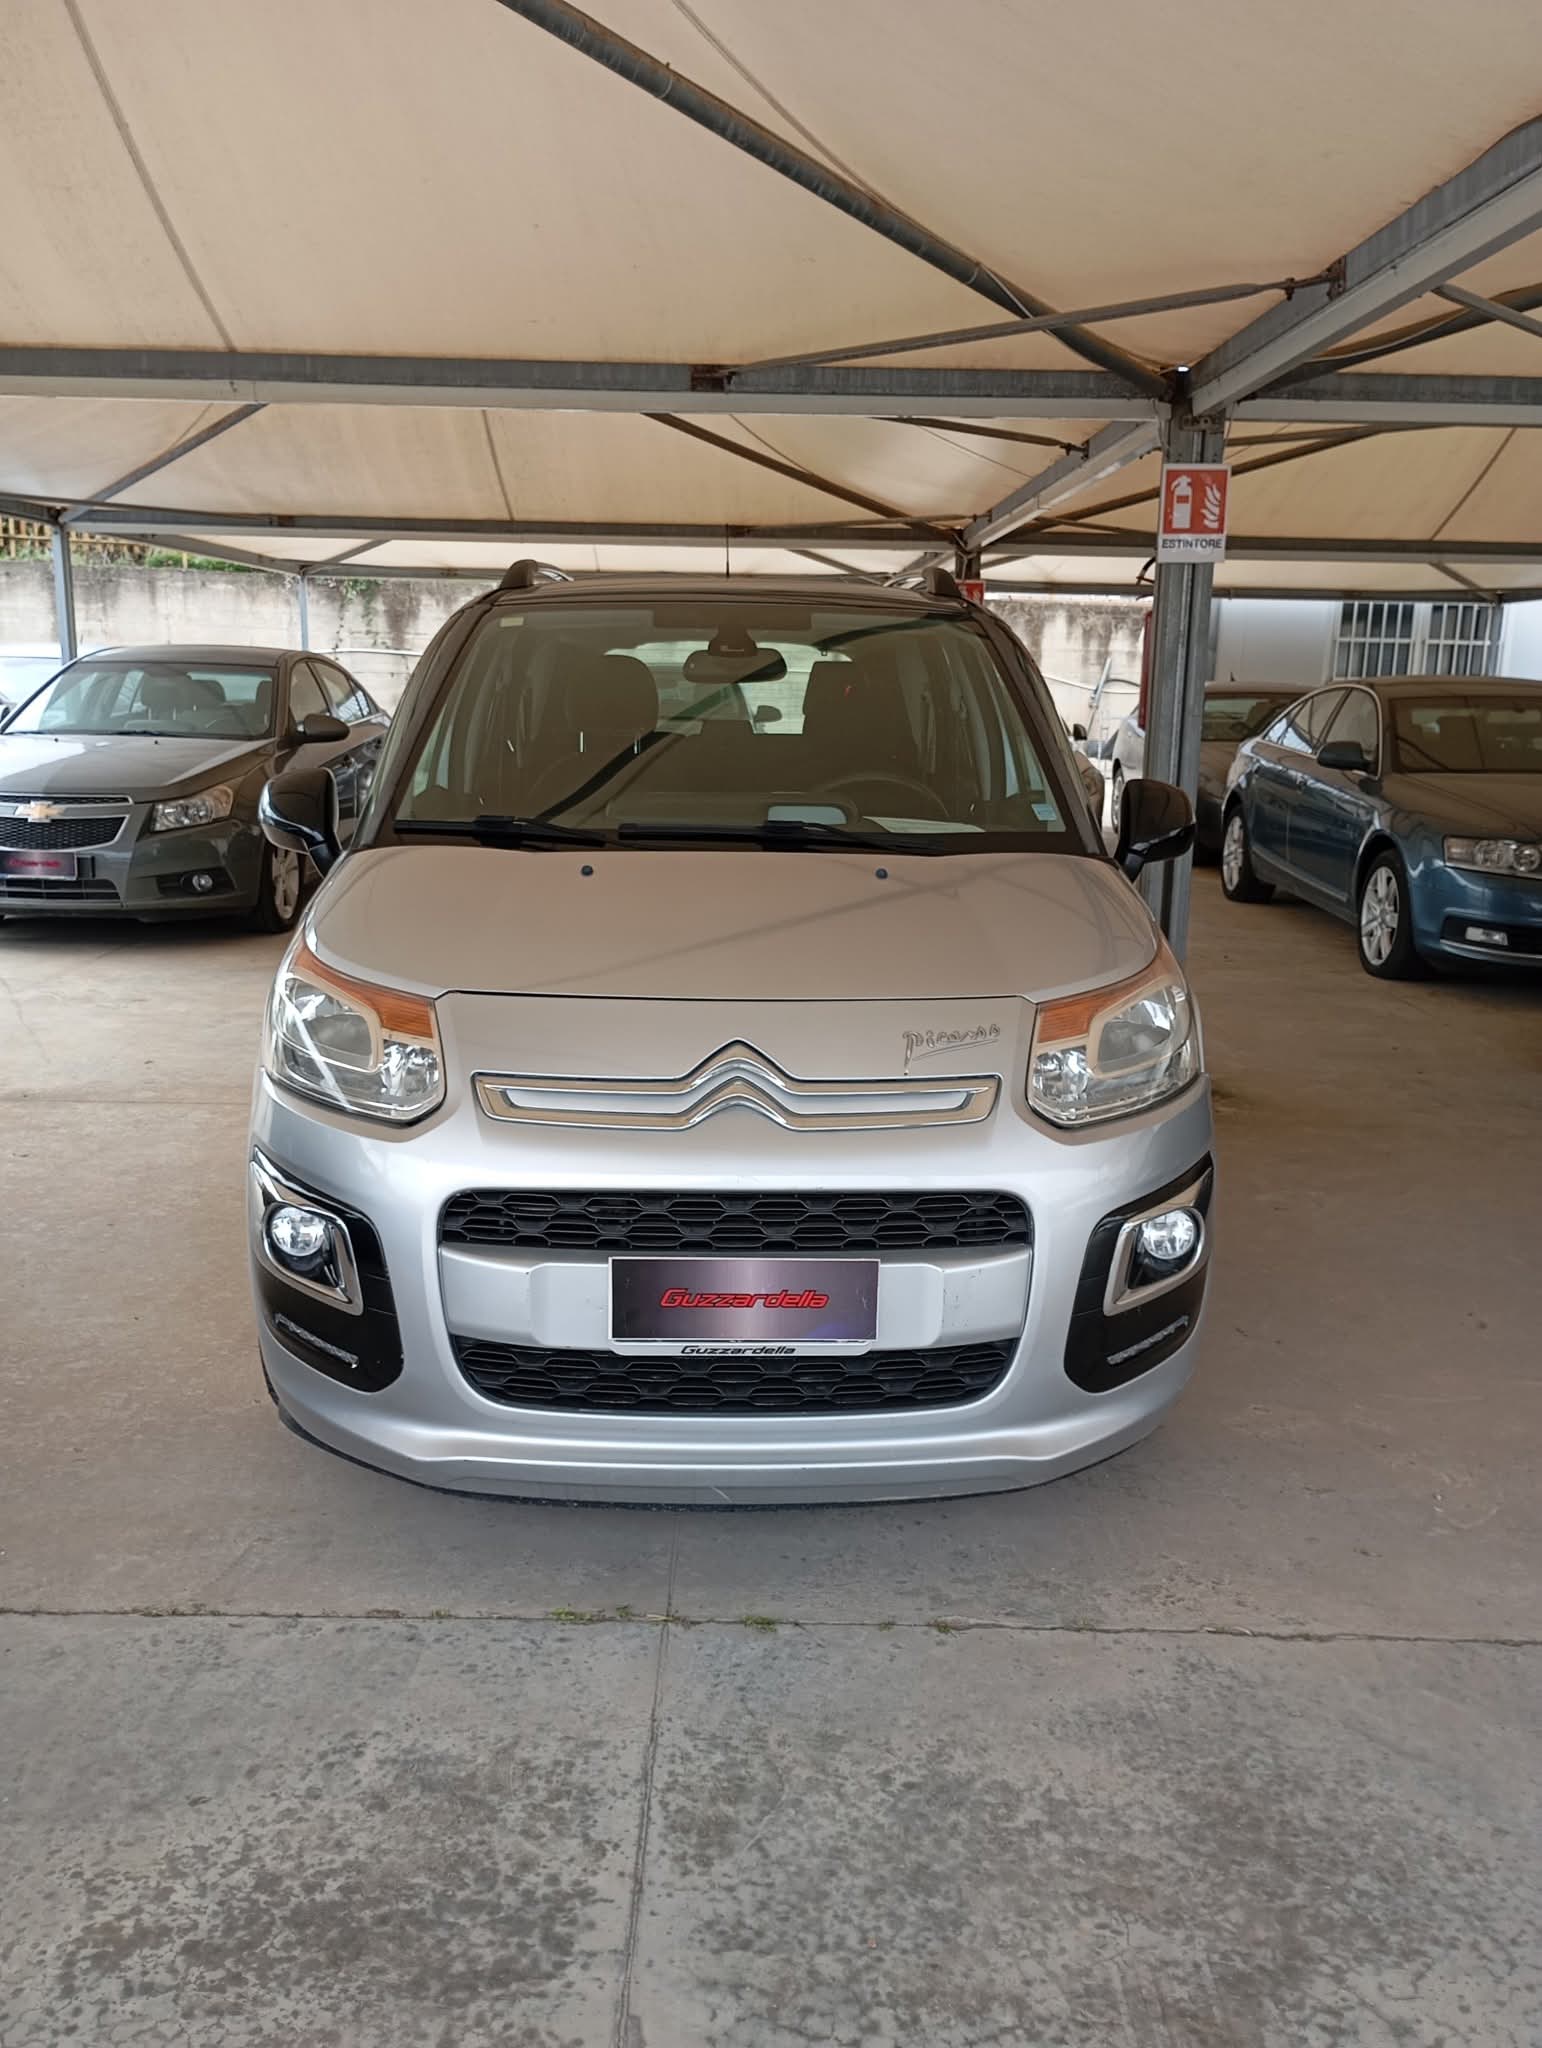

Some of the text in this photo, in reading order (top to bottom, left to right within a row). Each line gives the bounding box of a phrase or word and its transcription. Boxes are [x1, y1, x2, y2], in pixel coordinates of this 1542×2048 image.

[1162, 538, 1223, 549] ESTINTORE
[660, 1287, 830, 1309] Guzzardella
[681, 1345, 796, 1355] Guzzardella
